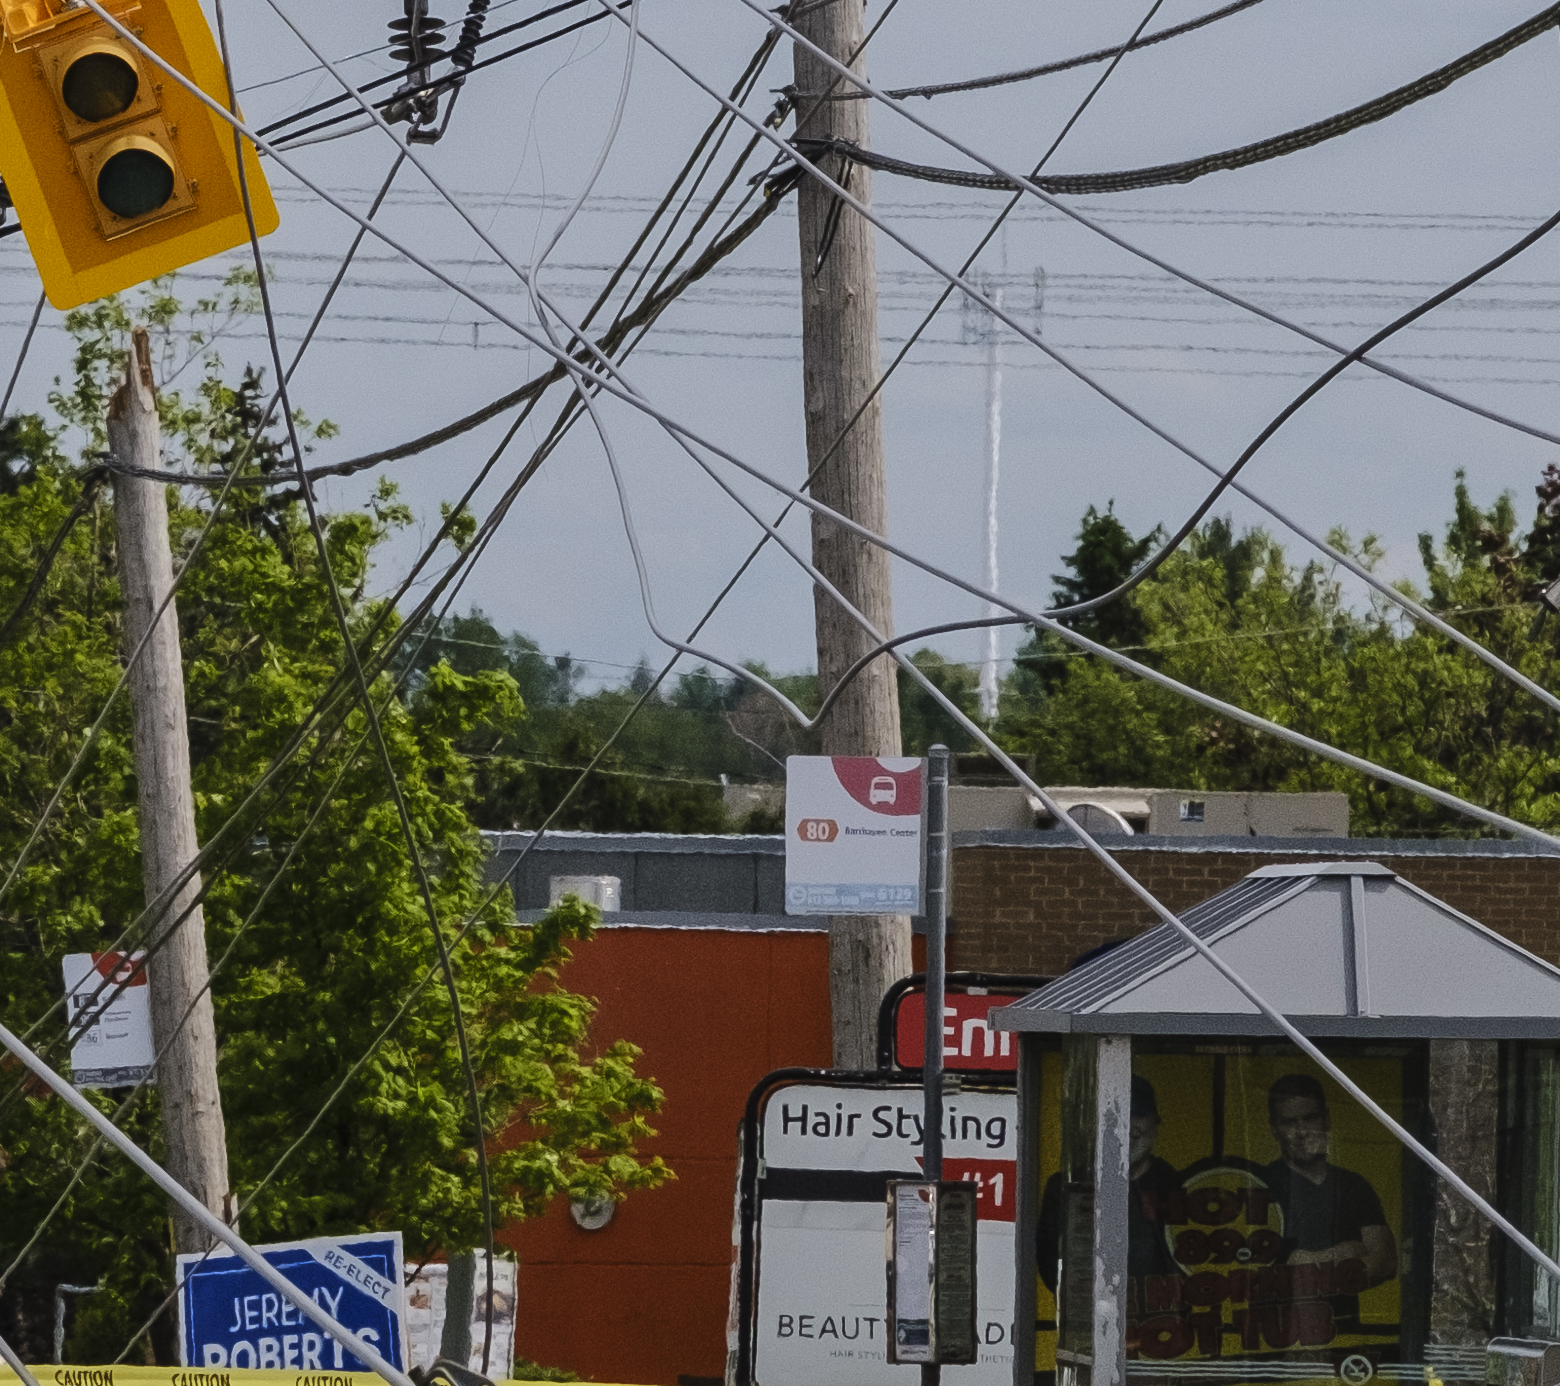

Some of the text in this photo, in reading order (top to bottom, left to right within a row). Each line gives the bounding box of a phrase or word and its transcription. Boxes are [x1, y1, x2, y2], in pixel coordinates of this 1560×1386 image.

[806, 821, 830, 841] 80
[781, 1102, 1007, 1149] Hair Stying
[323, 1249, 391, 1300] RE-ELECT
[776, 1313, 888, 1340] BEAUT
[857, 1350, 886, 1361] STYLI
